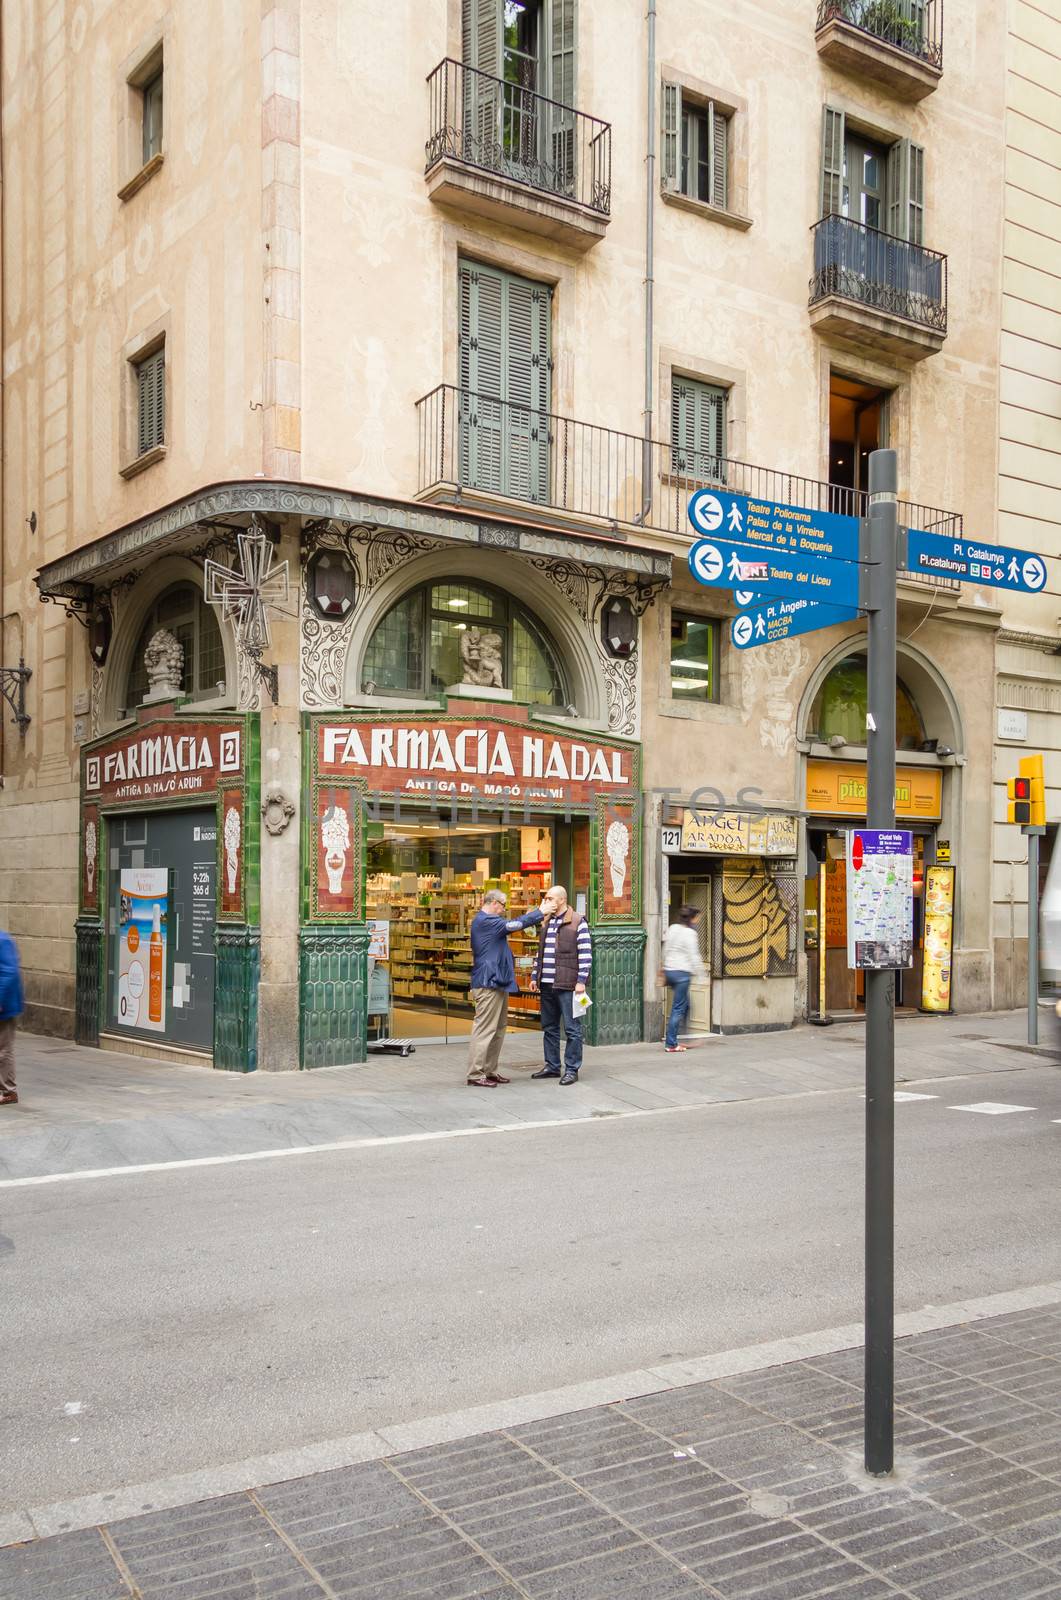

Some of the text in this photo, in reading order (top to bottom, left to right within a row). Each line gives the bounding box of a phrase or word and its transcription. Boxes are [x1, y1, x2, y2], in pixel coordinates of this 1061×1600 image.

[747, 501, 811, 522] Teatre Poliorama
[747, 516, 825, 538] Palau de la Virreina
[747, 529, 833, 553] Mercat de la Boqueria
[953, 544, 1005, 565] Pl. Catalunya
[770, 568, 831, 586] Teatre del Liceu
[767, 607, 777, 618] Pl.
[780, 600, 807, 614] Àngels
[768, 616, 792, 629] MACBA
[768, 627, 789, 640] CCCB
[90, 764, 97, 782] 2
[225, 741, 234, 762] 2
[523, 735, 629, 784] NADAL
[405, 779, 457, 793] ANTIGA
[484, 784, 520, 796] MASÓ
[662, 831, 680, 846] 121
[193, 872, 209, 882] 9-22h
[192, 885, 209, 895] 365 d
